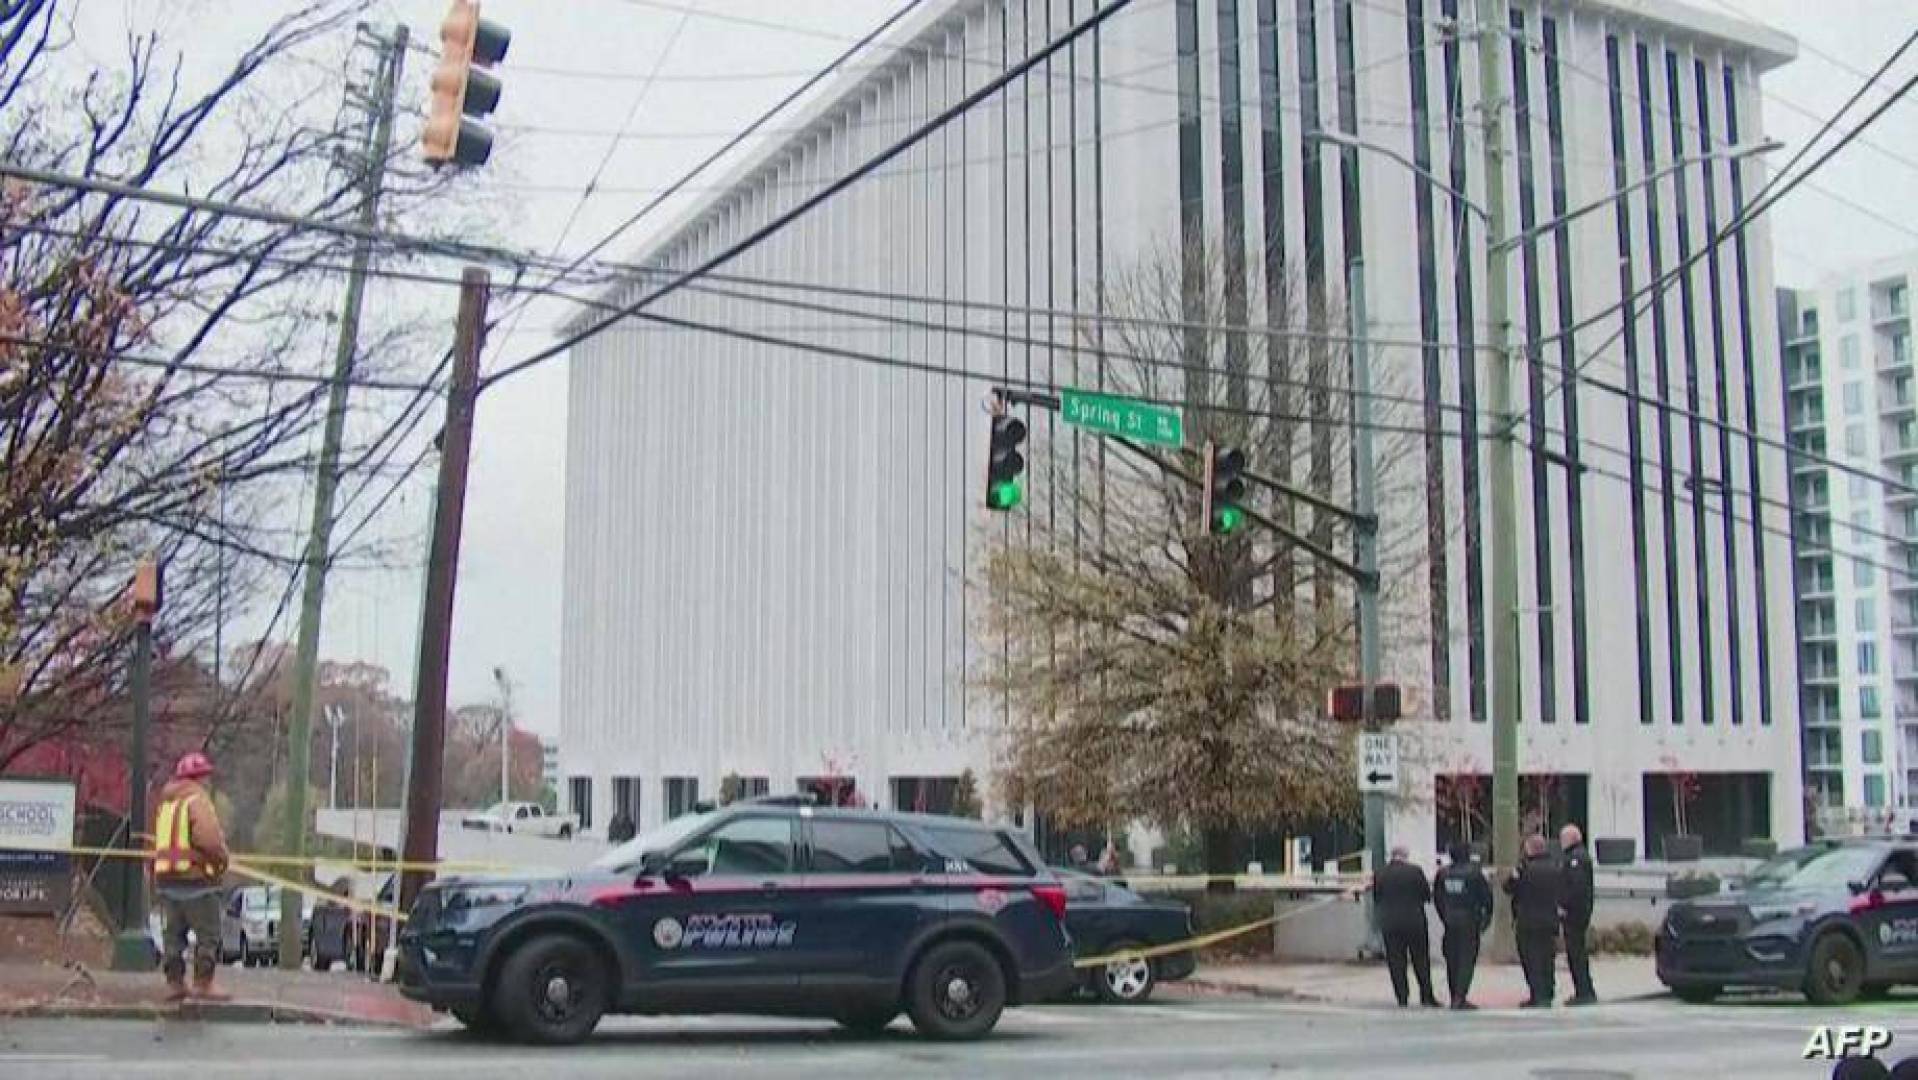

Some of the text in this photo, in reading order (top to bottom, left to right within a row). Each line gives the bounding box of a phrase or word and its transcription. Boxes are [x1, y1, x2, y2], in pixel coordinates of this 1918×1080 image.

[1071, 396, 1120, 432] Spring
[1127, 410, 1141, 430] St
[1365, 736, 1391, 750] ONE
[1365, 752, 1392, 767] WAY
